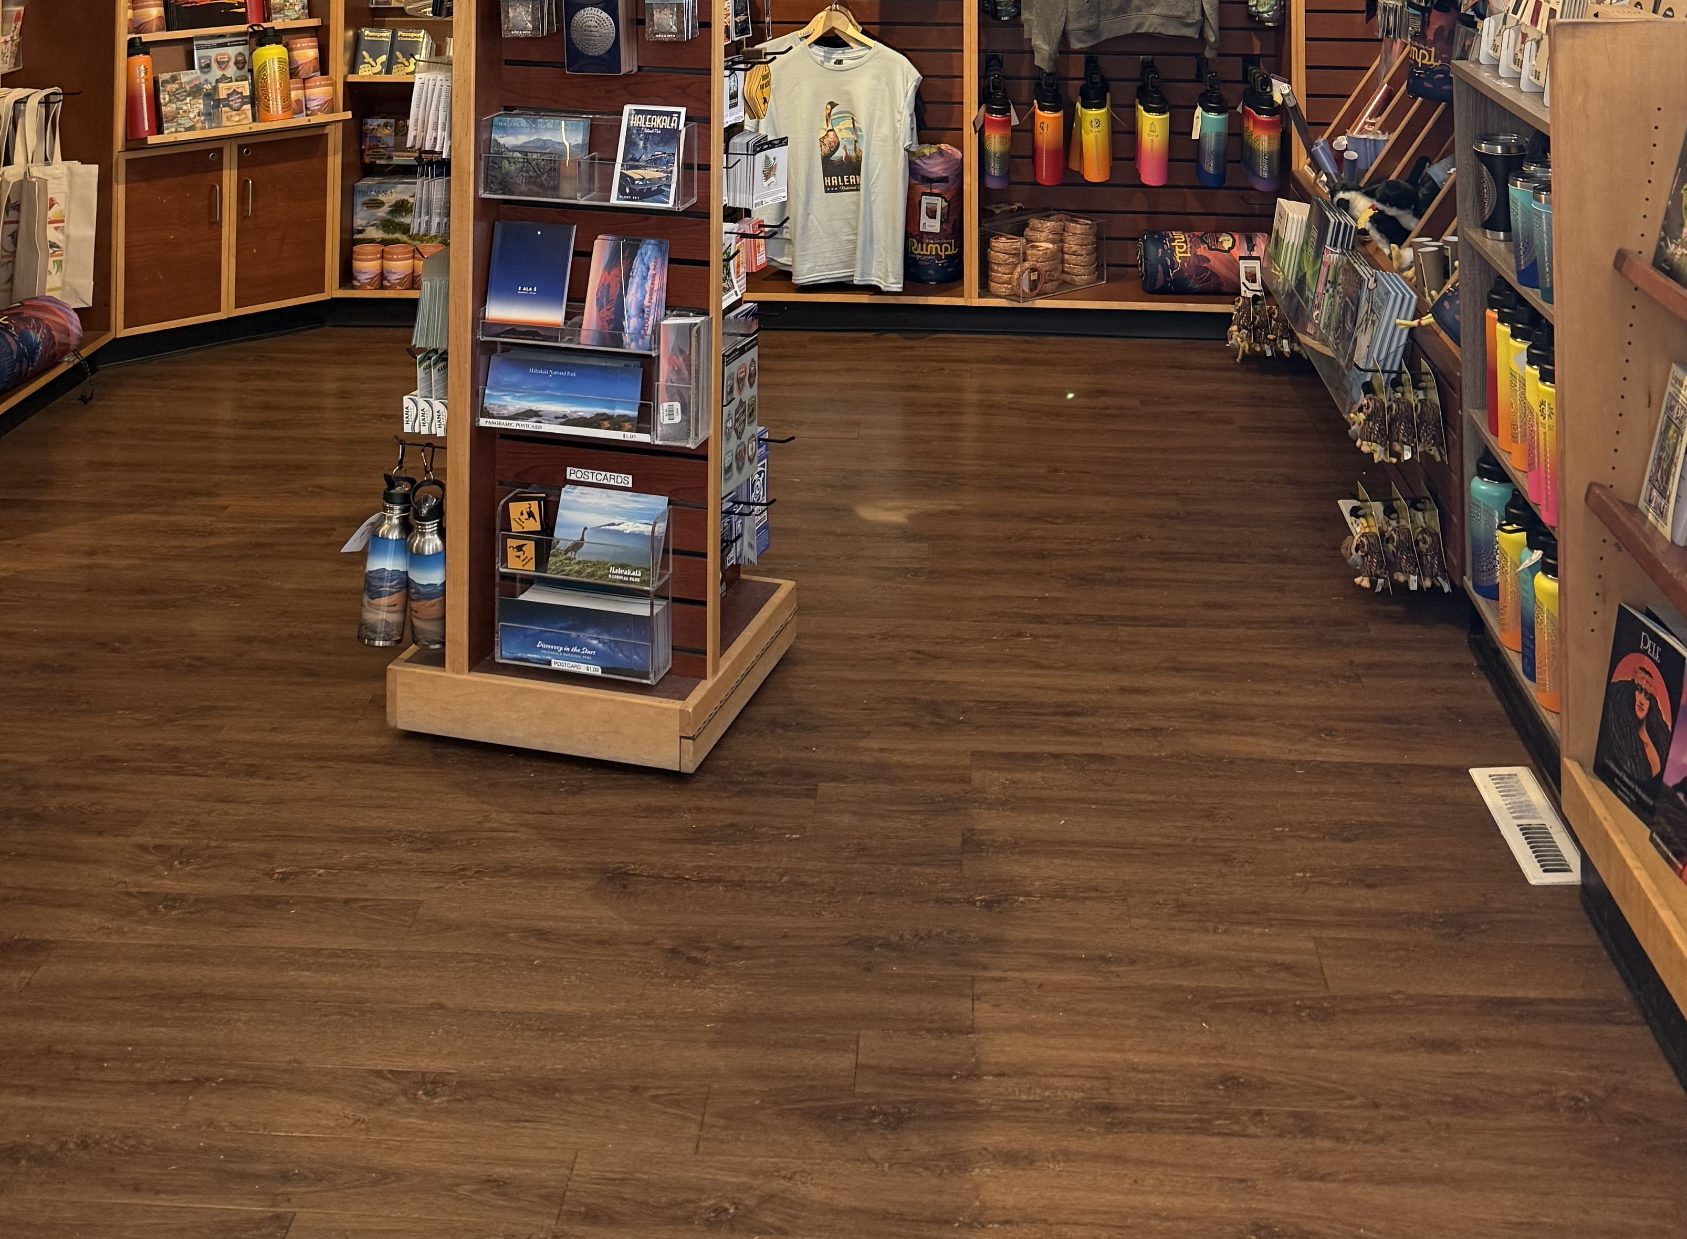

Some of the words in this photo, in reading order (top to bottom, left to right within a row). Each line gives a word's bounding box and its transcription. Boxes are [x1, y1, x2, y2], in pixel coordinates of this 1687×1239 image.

[630, 114, 678, 129] HALEAKALĀ
[569, 469, 630, 486] POSTCARDS
[536, 640, 563, 653] Discovery
[571, 646, 580, 654] the
[581, 647, 596, 656] Stars
[553, 661, 581, 670] POSTCARD
